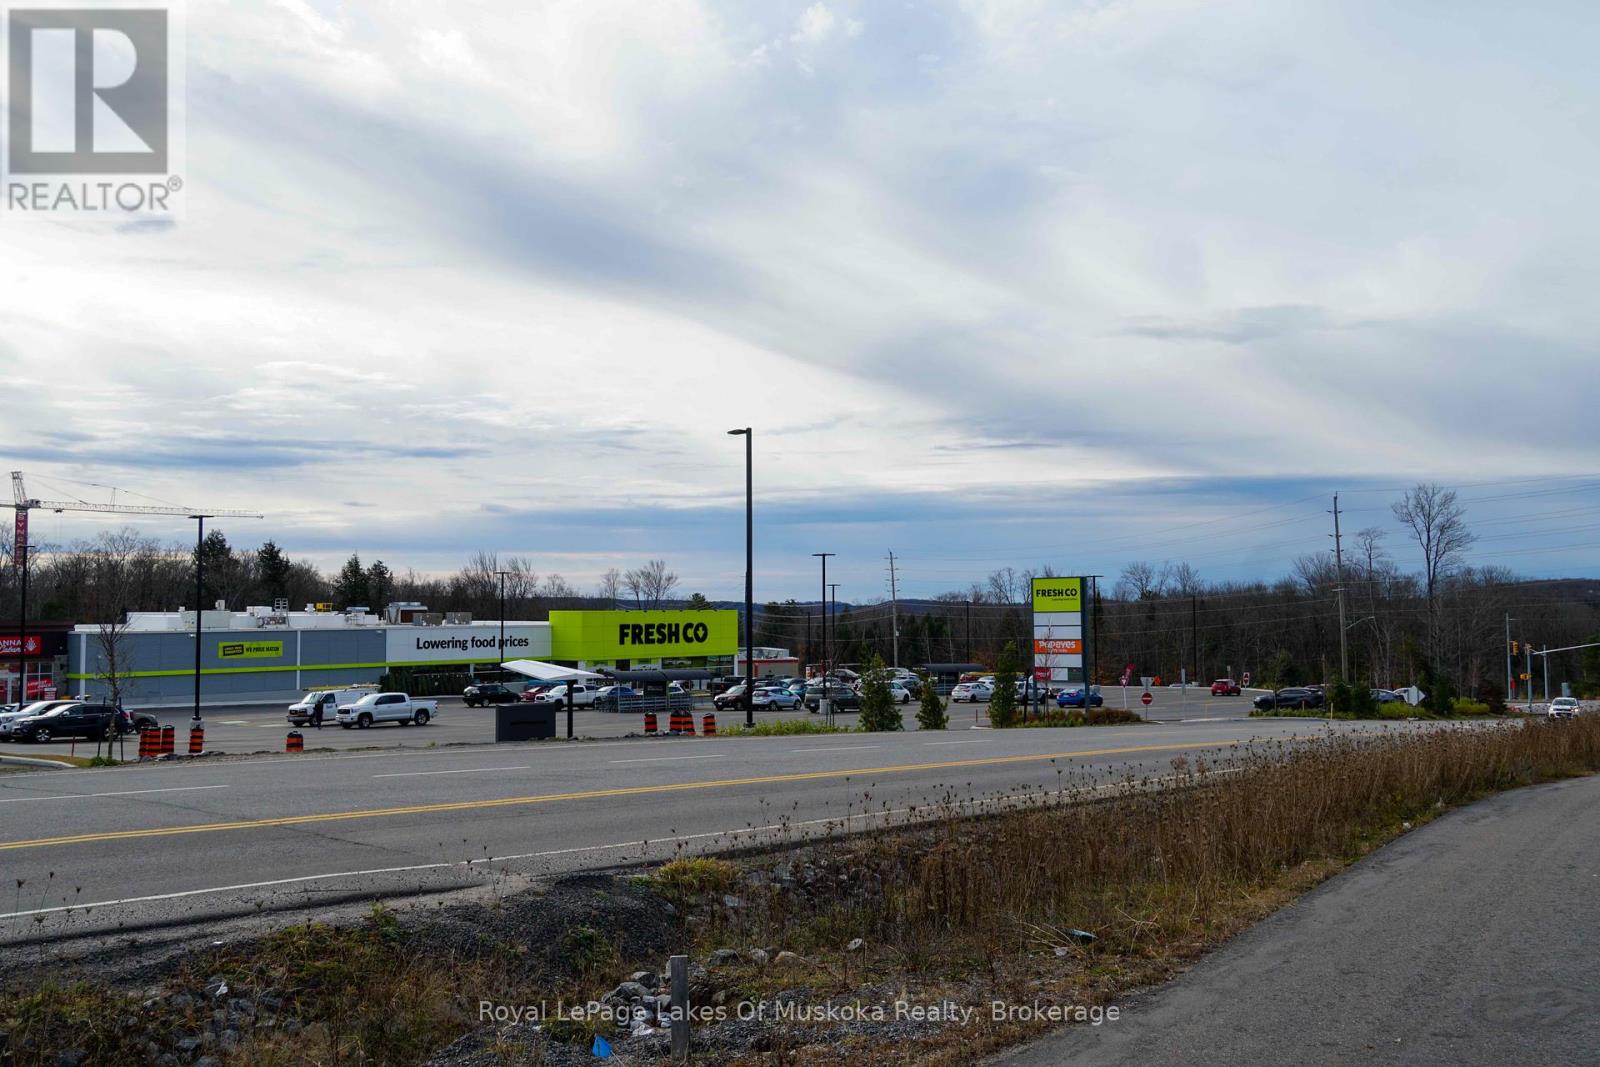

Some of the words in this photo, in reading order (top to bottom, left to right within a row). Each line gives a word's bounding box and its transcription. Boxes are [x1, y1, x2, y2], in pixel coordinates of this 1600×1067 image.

[416, 636, 468, 651] Lowering
[471, 635, 495, 648] food
[498, 635, 529, 650] prices
